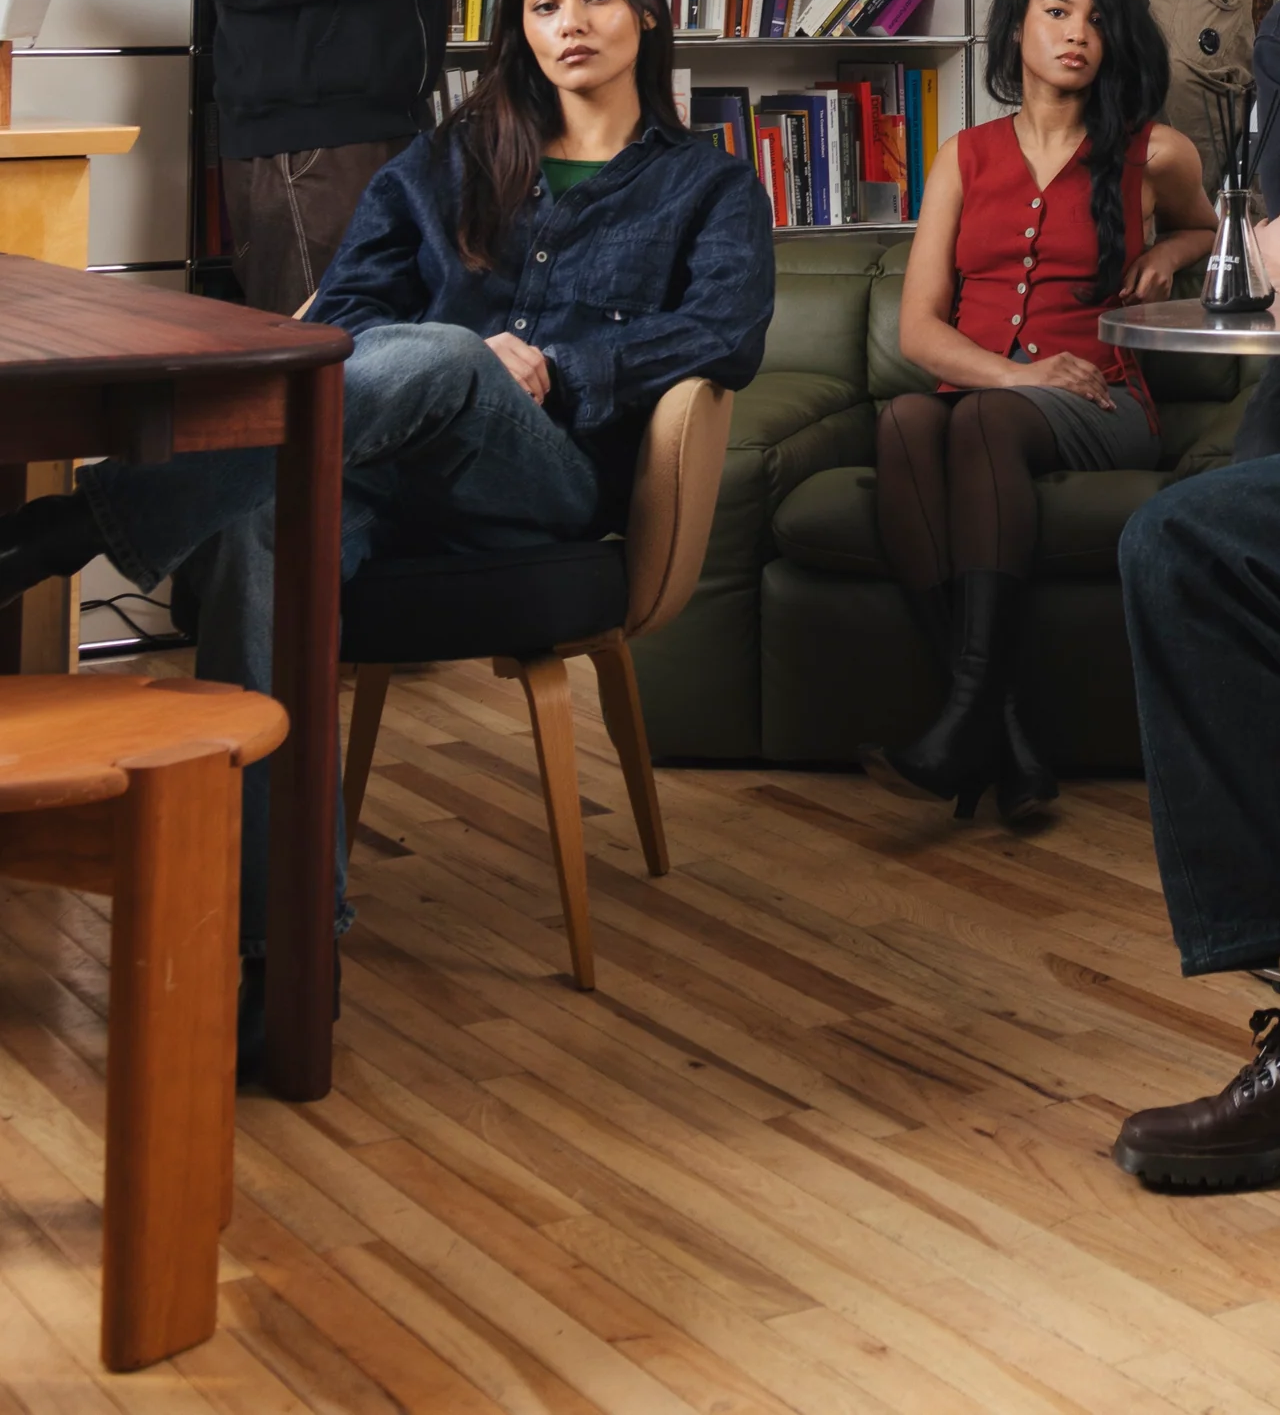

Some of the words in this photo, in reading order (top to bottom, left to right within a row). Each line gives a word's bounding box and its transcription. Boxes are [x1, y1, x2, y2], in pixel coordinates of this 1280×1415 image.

[692, 5, 698, 15] 7
[889, 5, 907, 30] Furniture
[870, 98, 881, 145] protest
